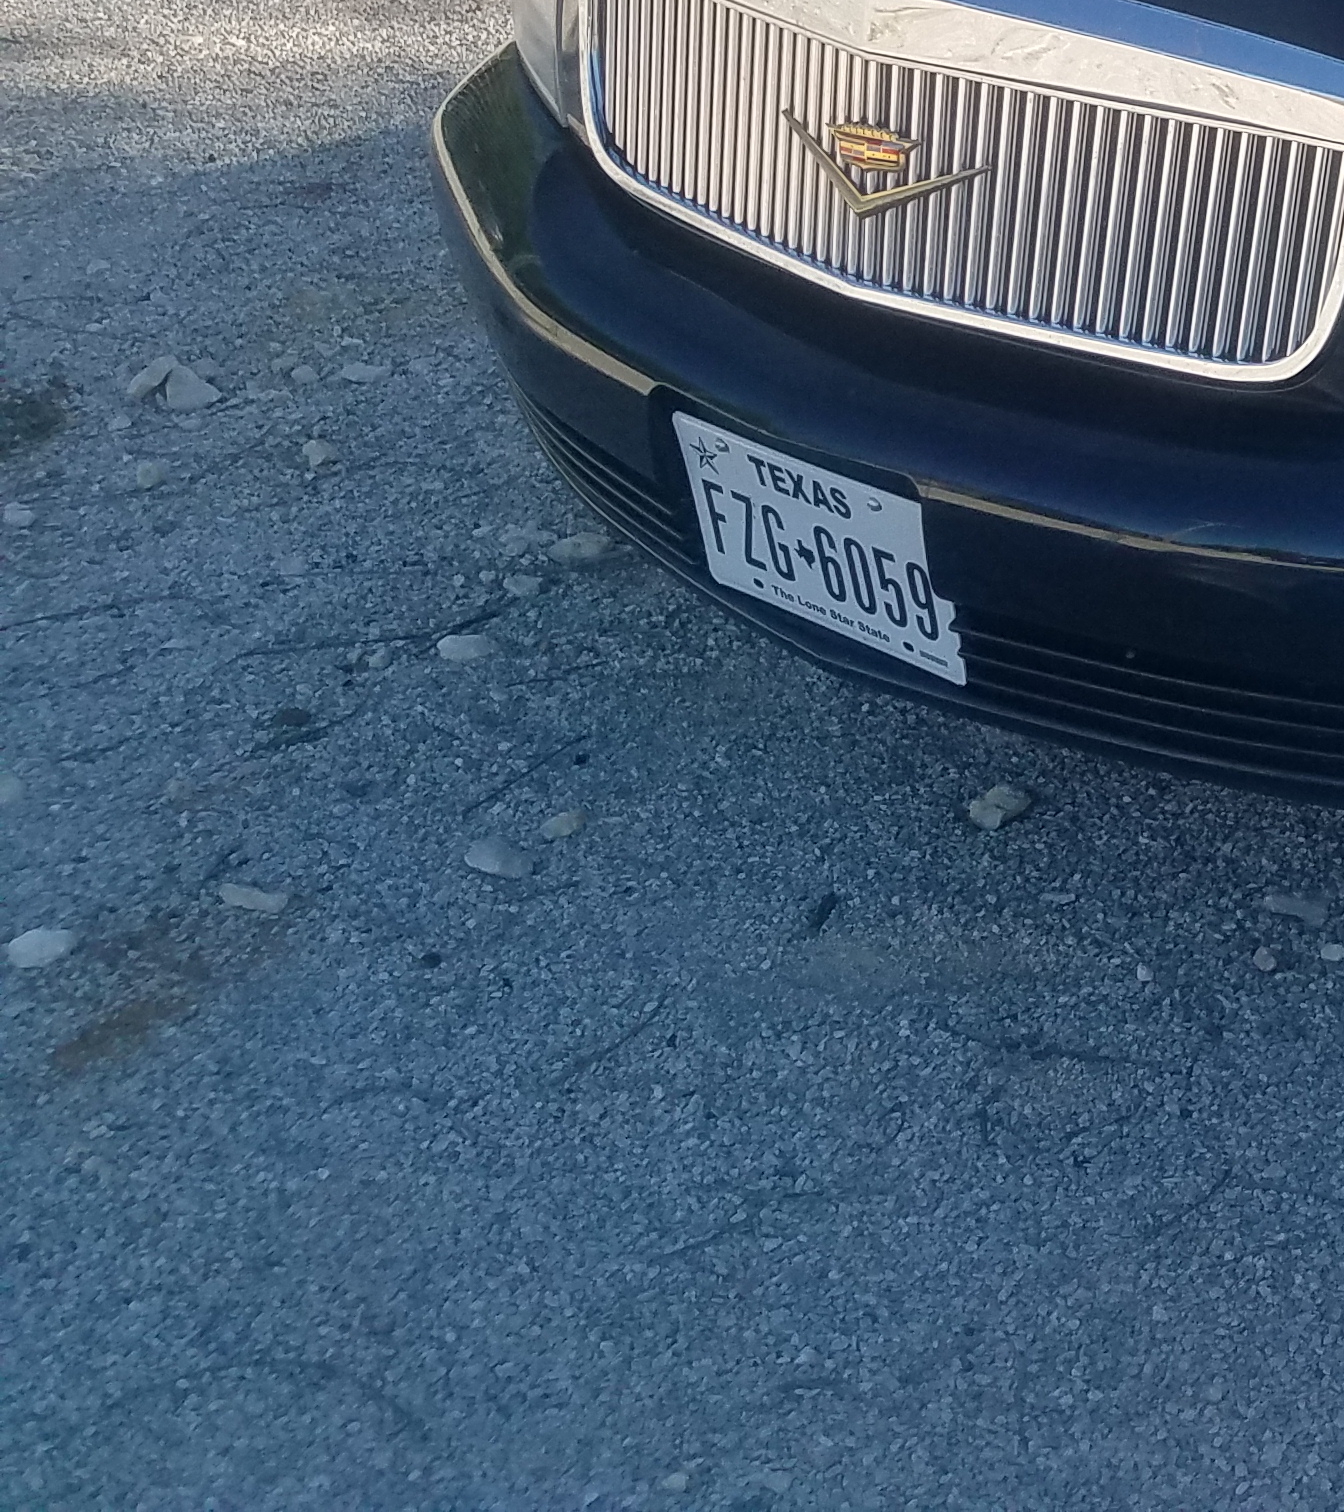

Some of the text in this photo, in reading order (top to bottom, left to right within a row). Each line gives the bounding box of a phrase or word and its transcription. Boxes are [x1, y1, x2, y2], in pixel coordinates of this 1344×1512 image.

[746, 454, 851, 520] TEXAS
[771, 584, 891, 643] The Lone Star State
